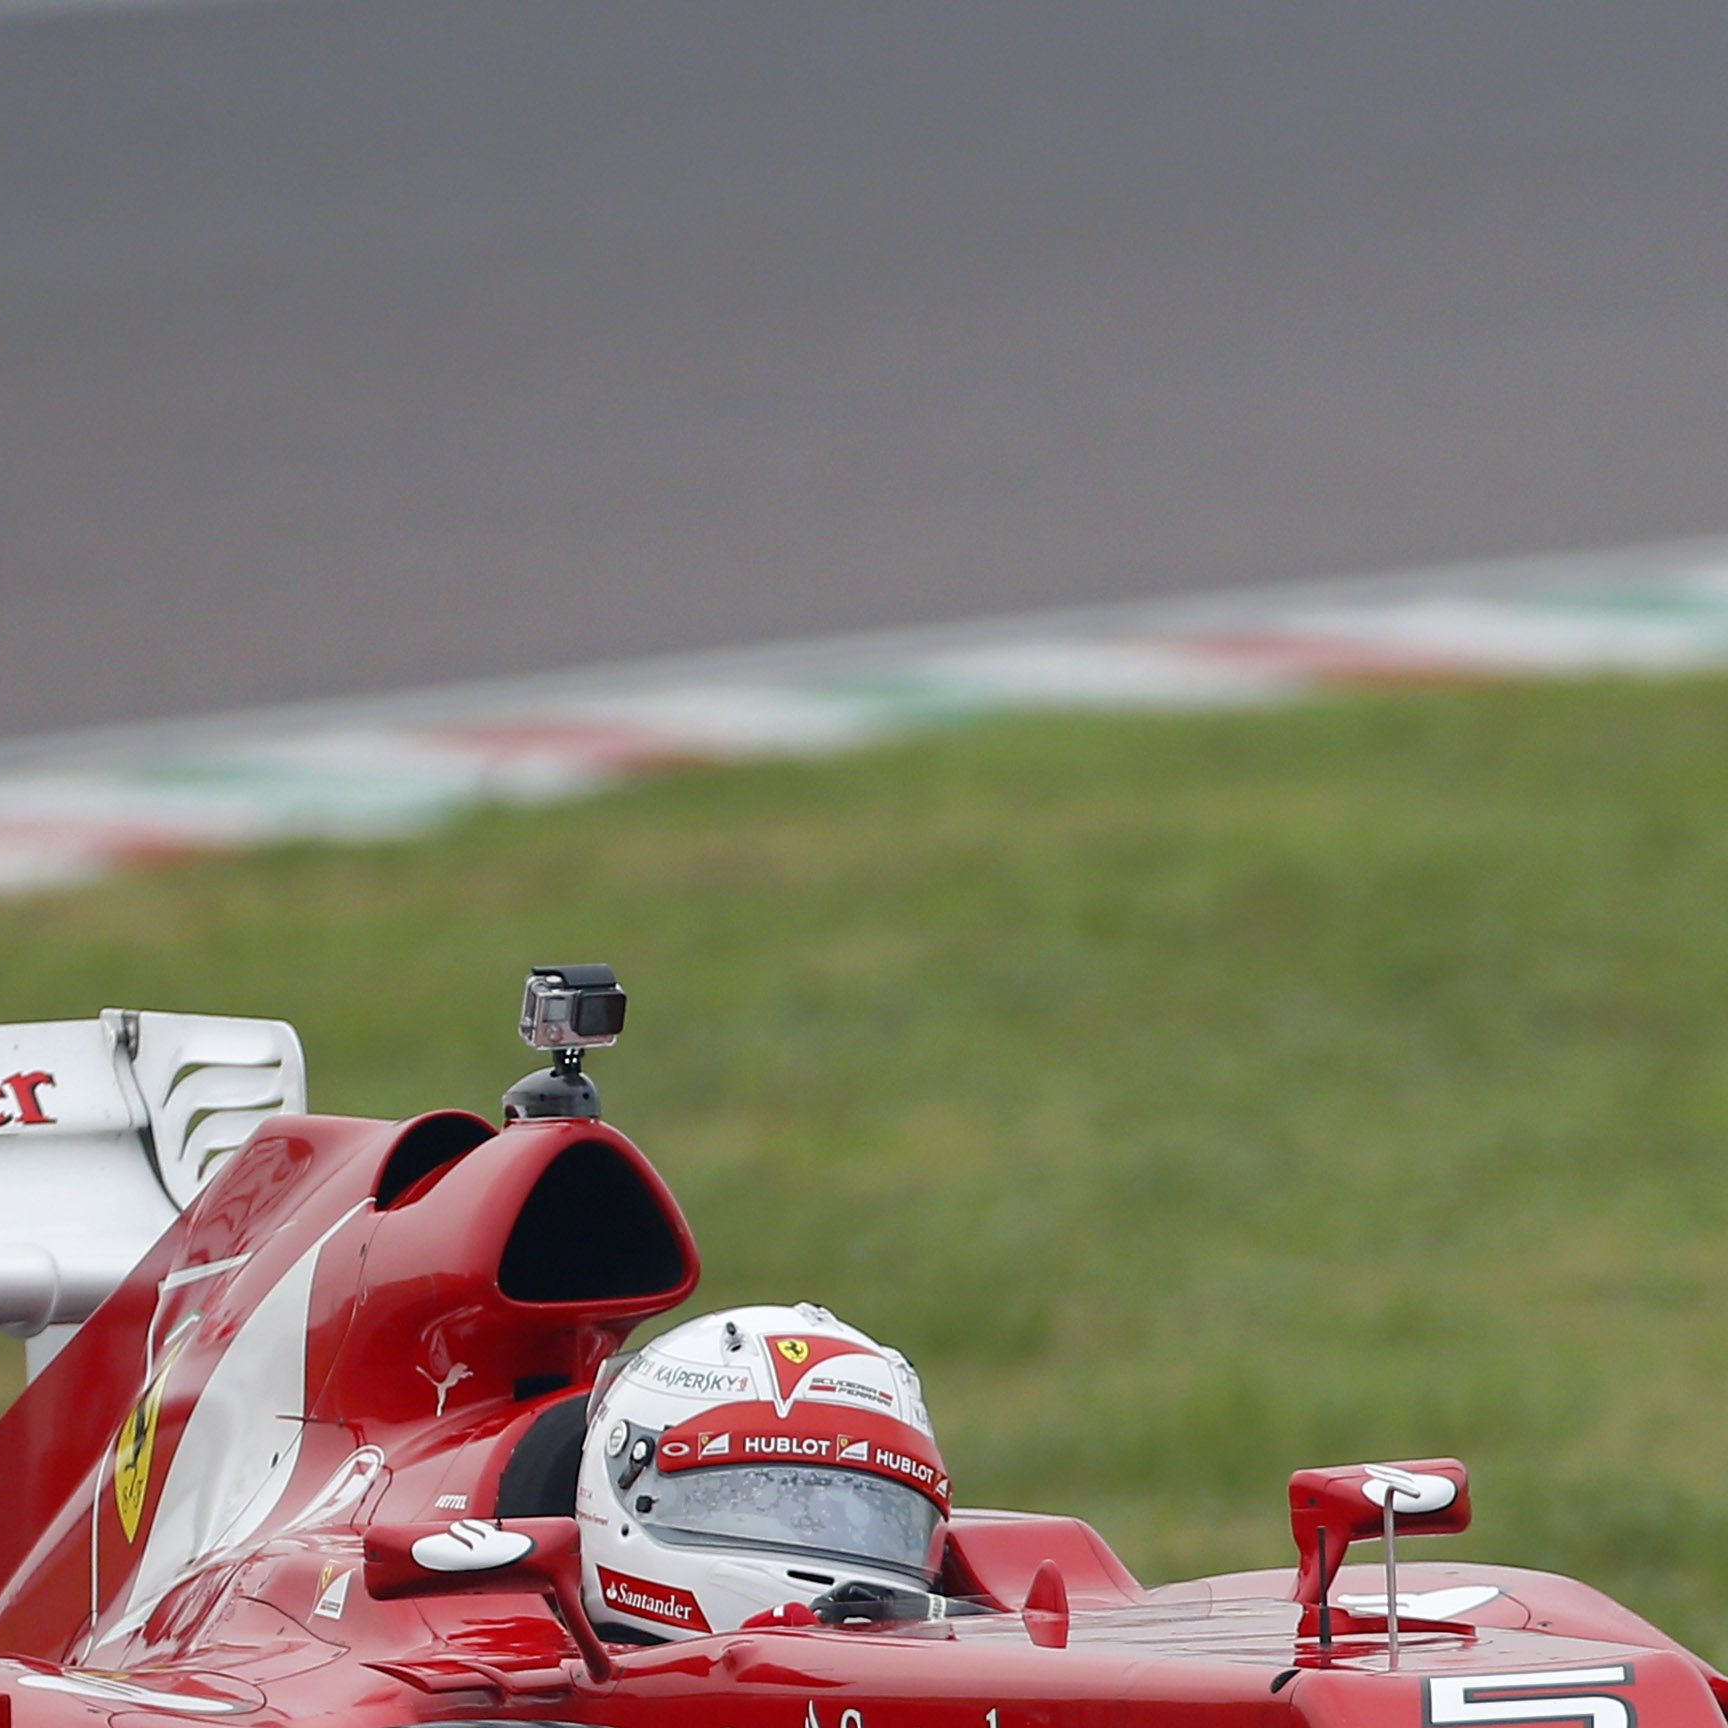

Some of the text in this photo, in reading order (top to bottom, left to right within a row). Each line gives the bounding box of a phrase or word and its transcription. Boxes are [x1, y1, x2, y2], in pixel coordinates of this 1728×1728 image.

[745, 1436, 831, 1456] HUBLOT
[875, 1448, 934, 1484] HUBLOT
[617, 1582, 692, 1620] Santander
